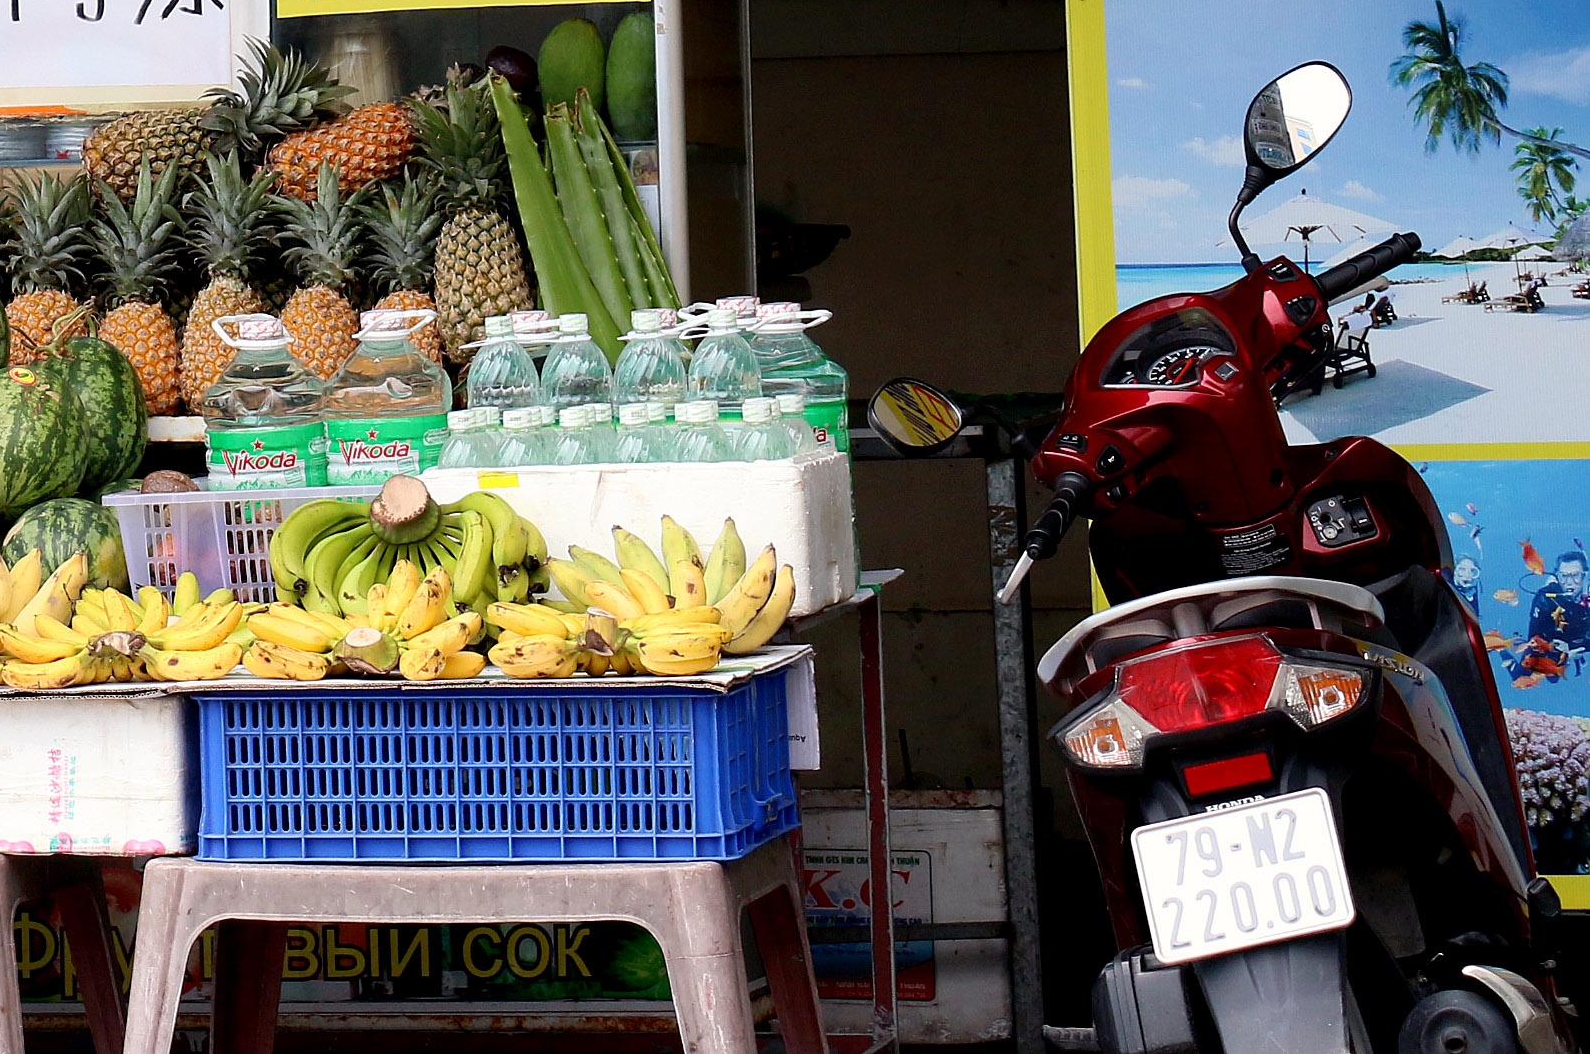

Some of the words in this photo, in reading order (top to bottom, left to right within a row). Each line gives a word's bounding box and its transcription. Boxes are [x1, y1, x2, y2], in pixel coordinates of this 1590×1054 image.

[222, 449, 298, 478] Vikoda
[337, 438, 410, 467] Vikoda
[1205, 794, 1266, 812] HONDA
[1165, 808, 1306, 886] 79-N2
[1162, 865, 1337, 950] 220.00
